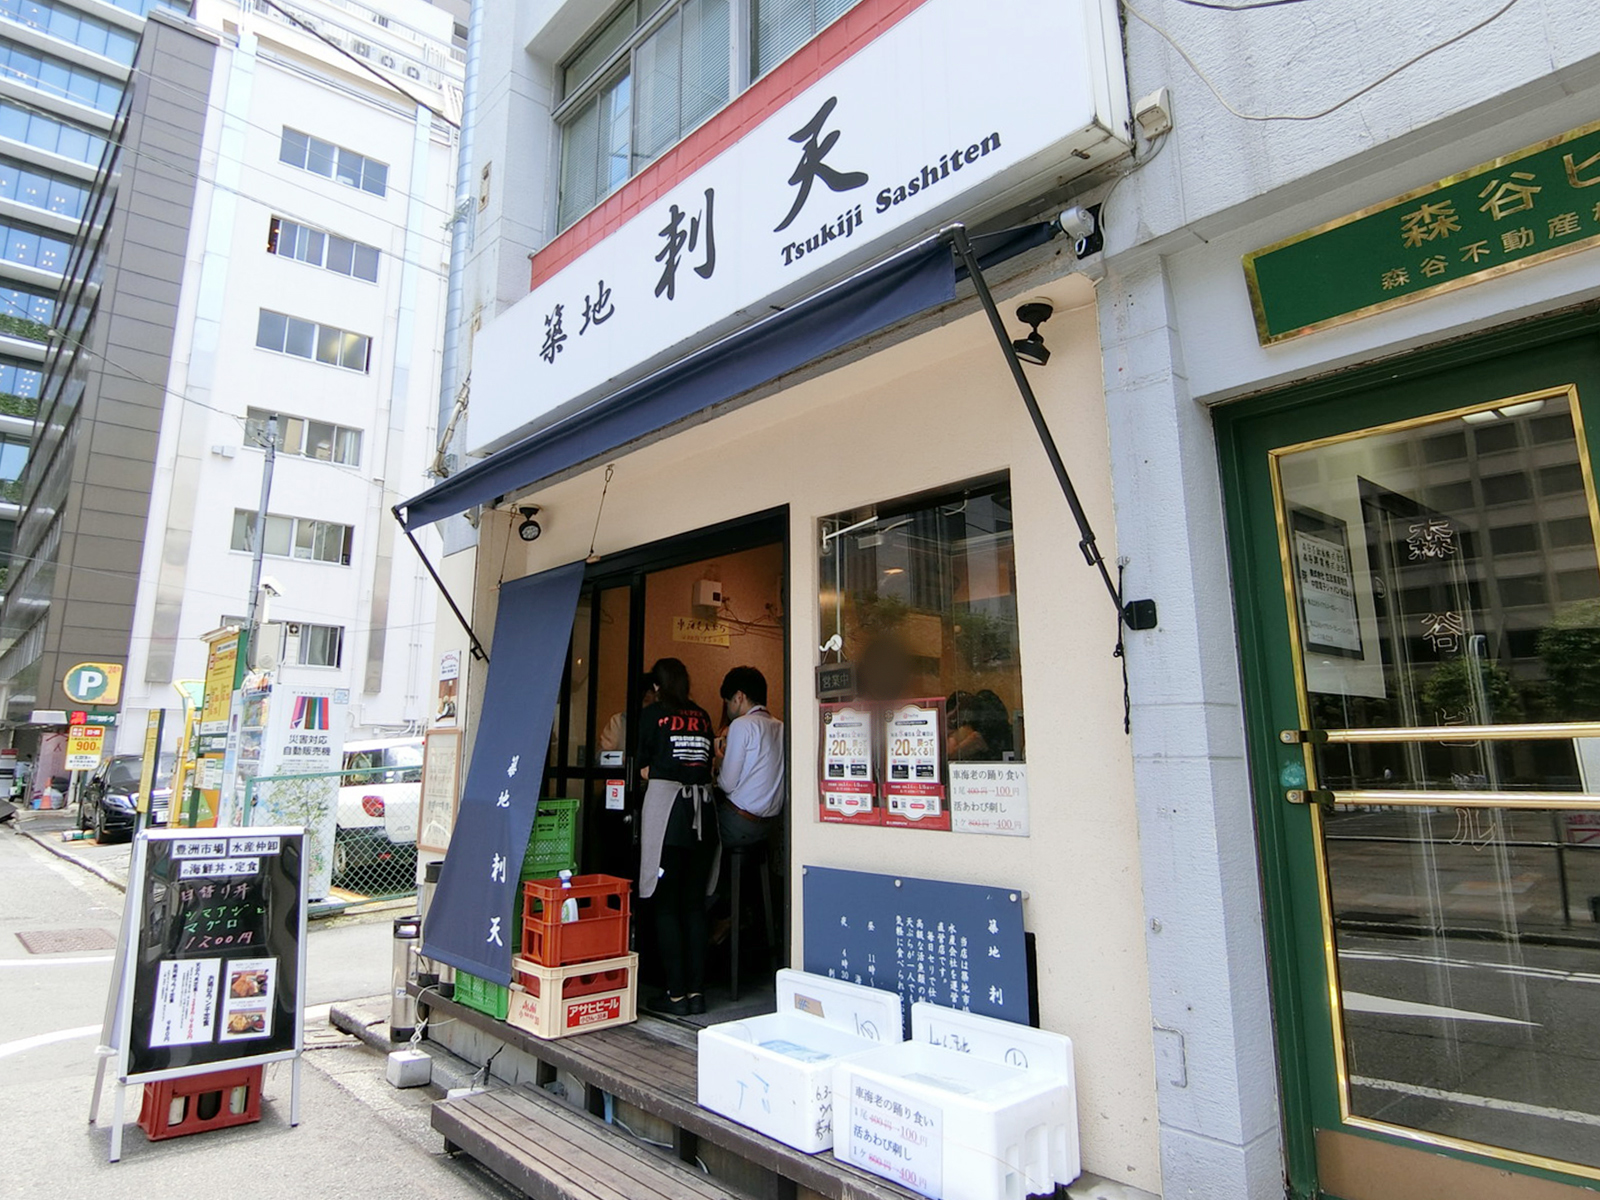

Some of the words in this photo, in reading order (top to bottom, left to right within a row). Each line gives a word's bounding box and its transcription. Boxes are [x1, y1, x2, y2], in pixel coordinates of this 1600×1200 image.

[780, 204, 864, 266] Tsukiji
[875, 131, 1001, 214] Sashiten
[1382, 202, 1600, 290] 森谷不動産
[539, 280, 616, 365] 築地
[78, 671, 103, 696] P
[822, 673, 849, 689] 営業中
[288, 734, 328, 745] 災害対応
[283, 746, 331, 757] 自動販売機
[953, 769, 1025, 781] 車海老の踊り食い
[954, 800, 1007, 813] 活あわび刺し
[175, 843, 225, 856] 豊洲市場
[231, 840, 279, 853] 水産仲卸
[183, 919, 238, 933] マグロ
[569, 998, 619, 1017] アサヒビール
[855, 1086, 934, 1127] 車海老の踊り食い
[853, 1124, 913, 1162] 活あわび刺し
